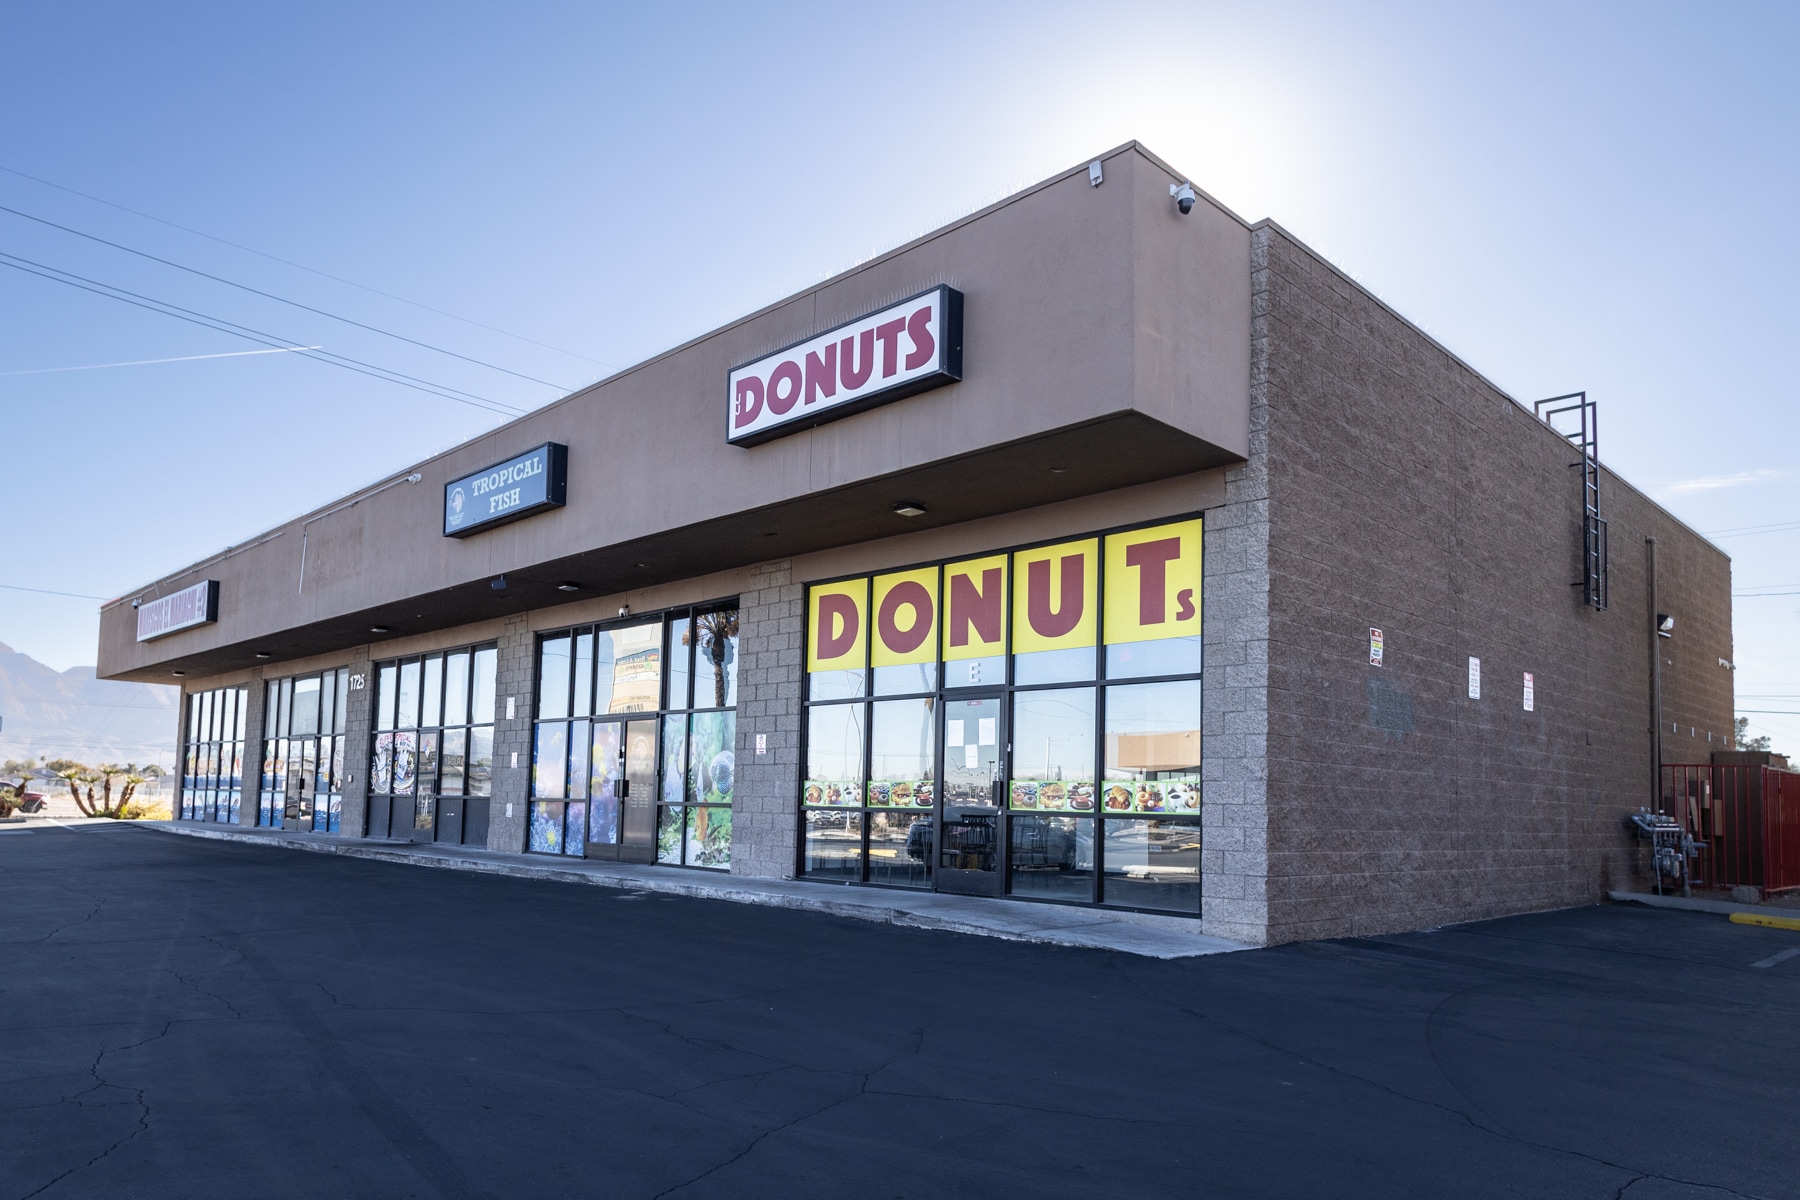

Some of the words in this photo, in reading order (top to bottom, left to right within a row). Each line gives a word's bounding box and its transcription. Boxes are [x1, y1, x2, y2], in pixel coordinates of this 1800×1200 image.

[734, 305, 935, 430] DONUTS
[472, 457, 542, 497] TROPICAL
[489, 488, 520, 513] FISH
[350, 673, 365, 691] 1725
[968, 662, 981, 684] E
